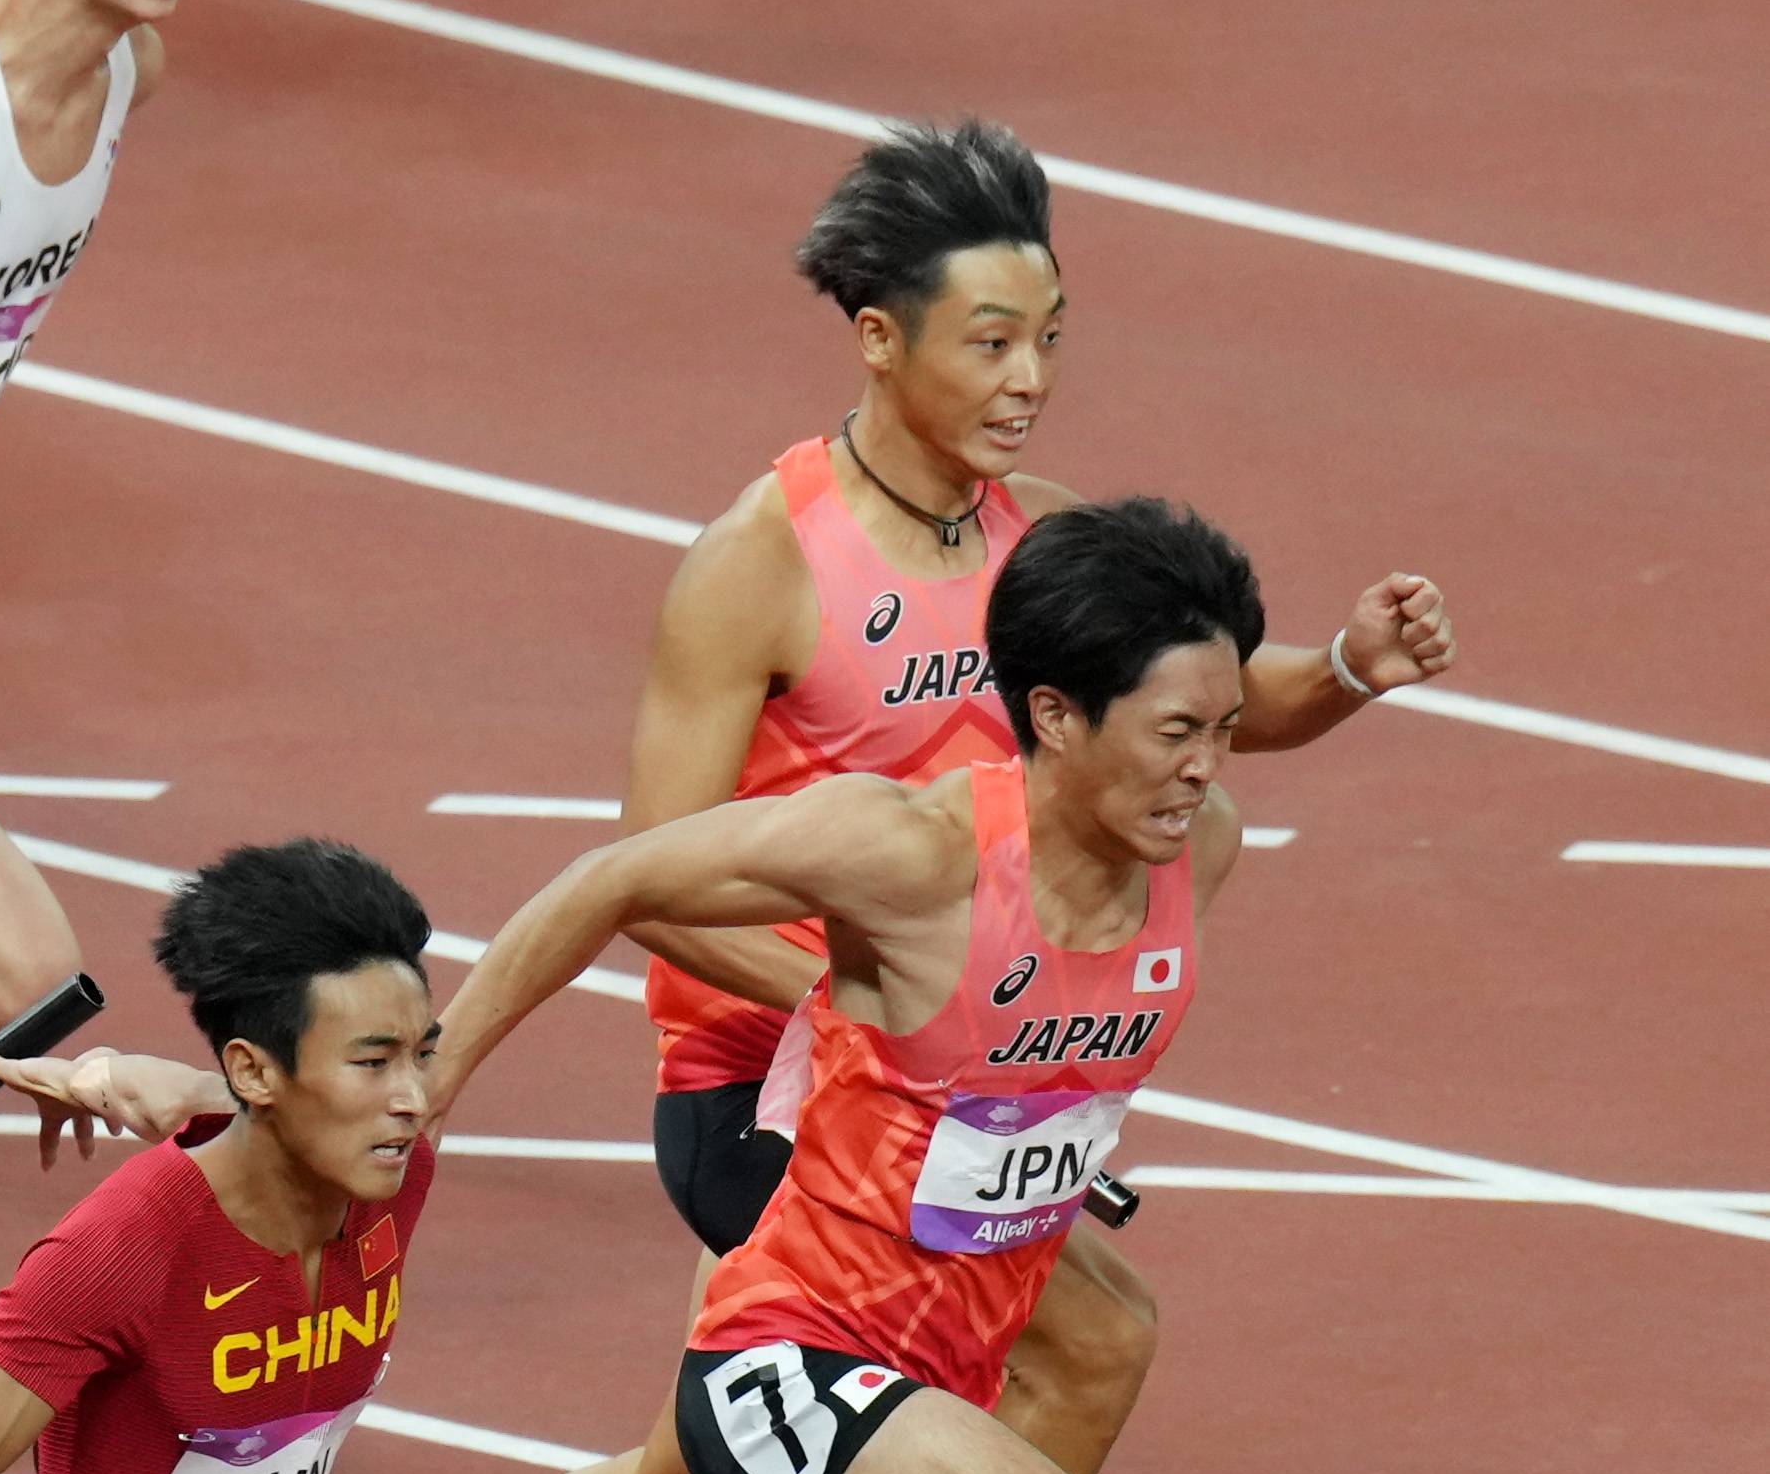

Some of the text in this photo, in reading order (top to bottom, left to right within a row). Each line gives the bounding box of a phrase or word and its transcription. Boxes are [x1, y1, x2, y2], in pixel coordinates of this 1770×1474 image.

[882, 646, 1000, 708] JAPA
[985, 1008, 1165, 1066] JAPAN
[975, 1138, 1094, 1203] JPN
[213, 1273, 401, 1394] CHINA
